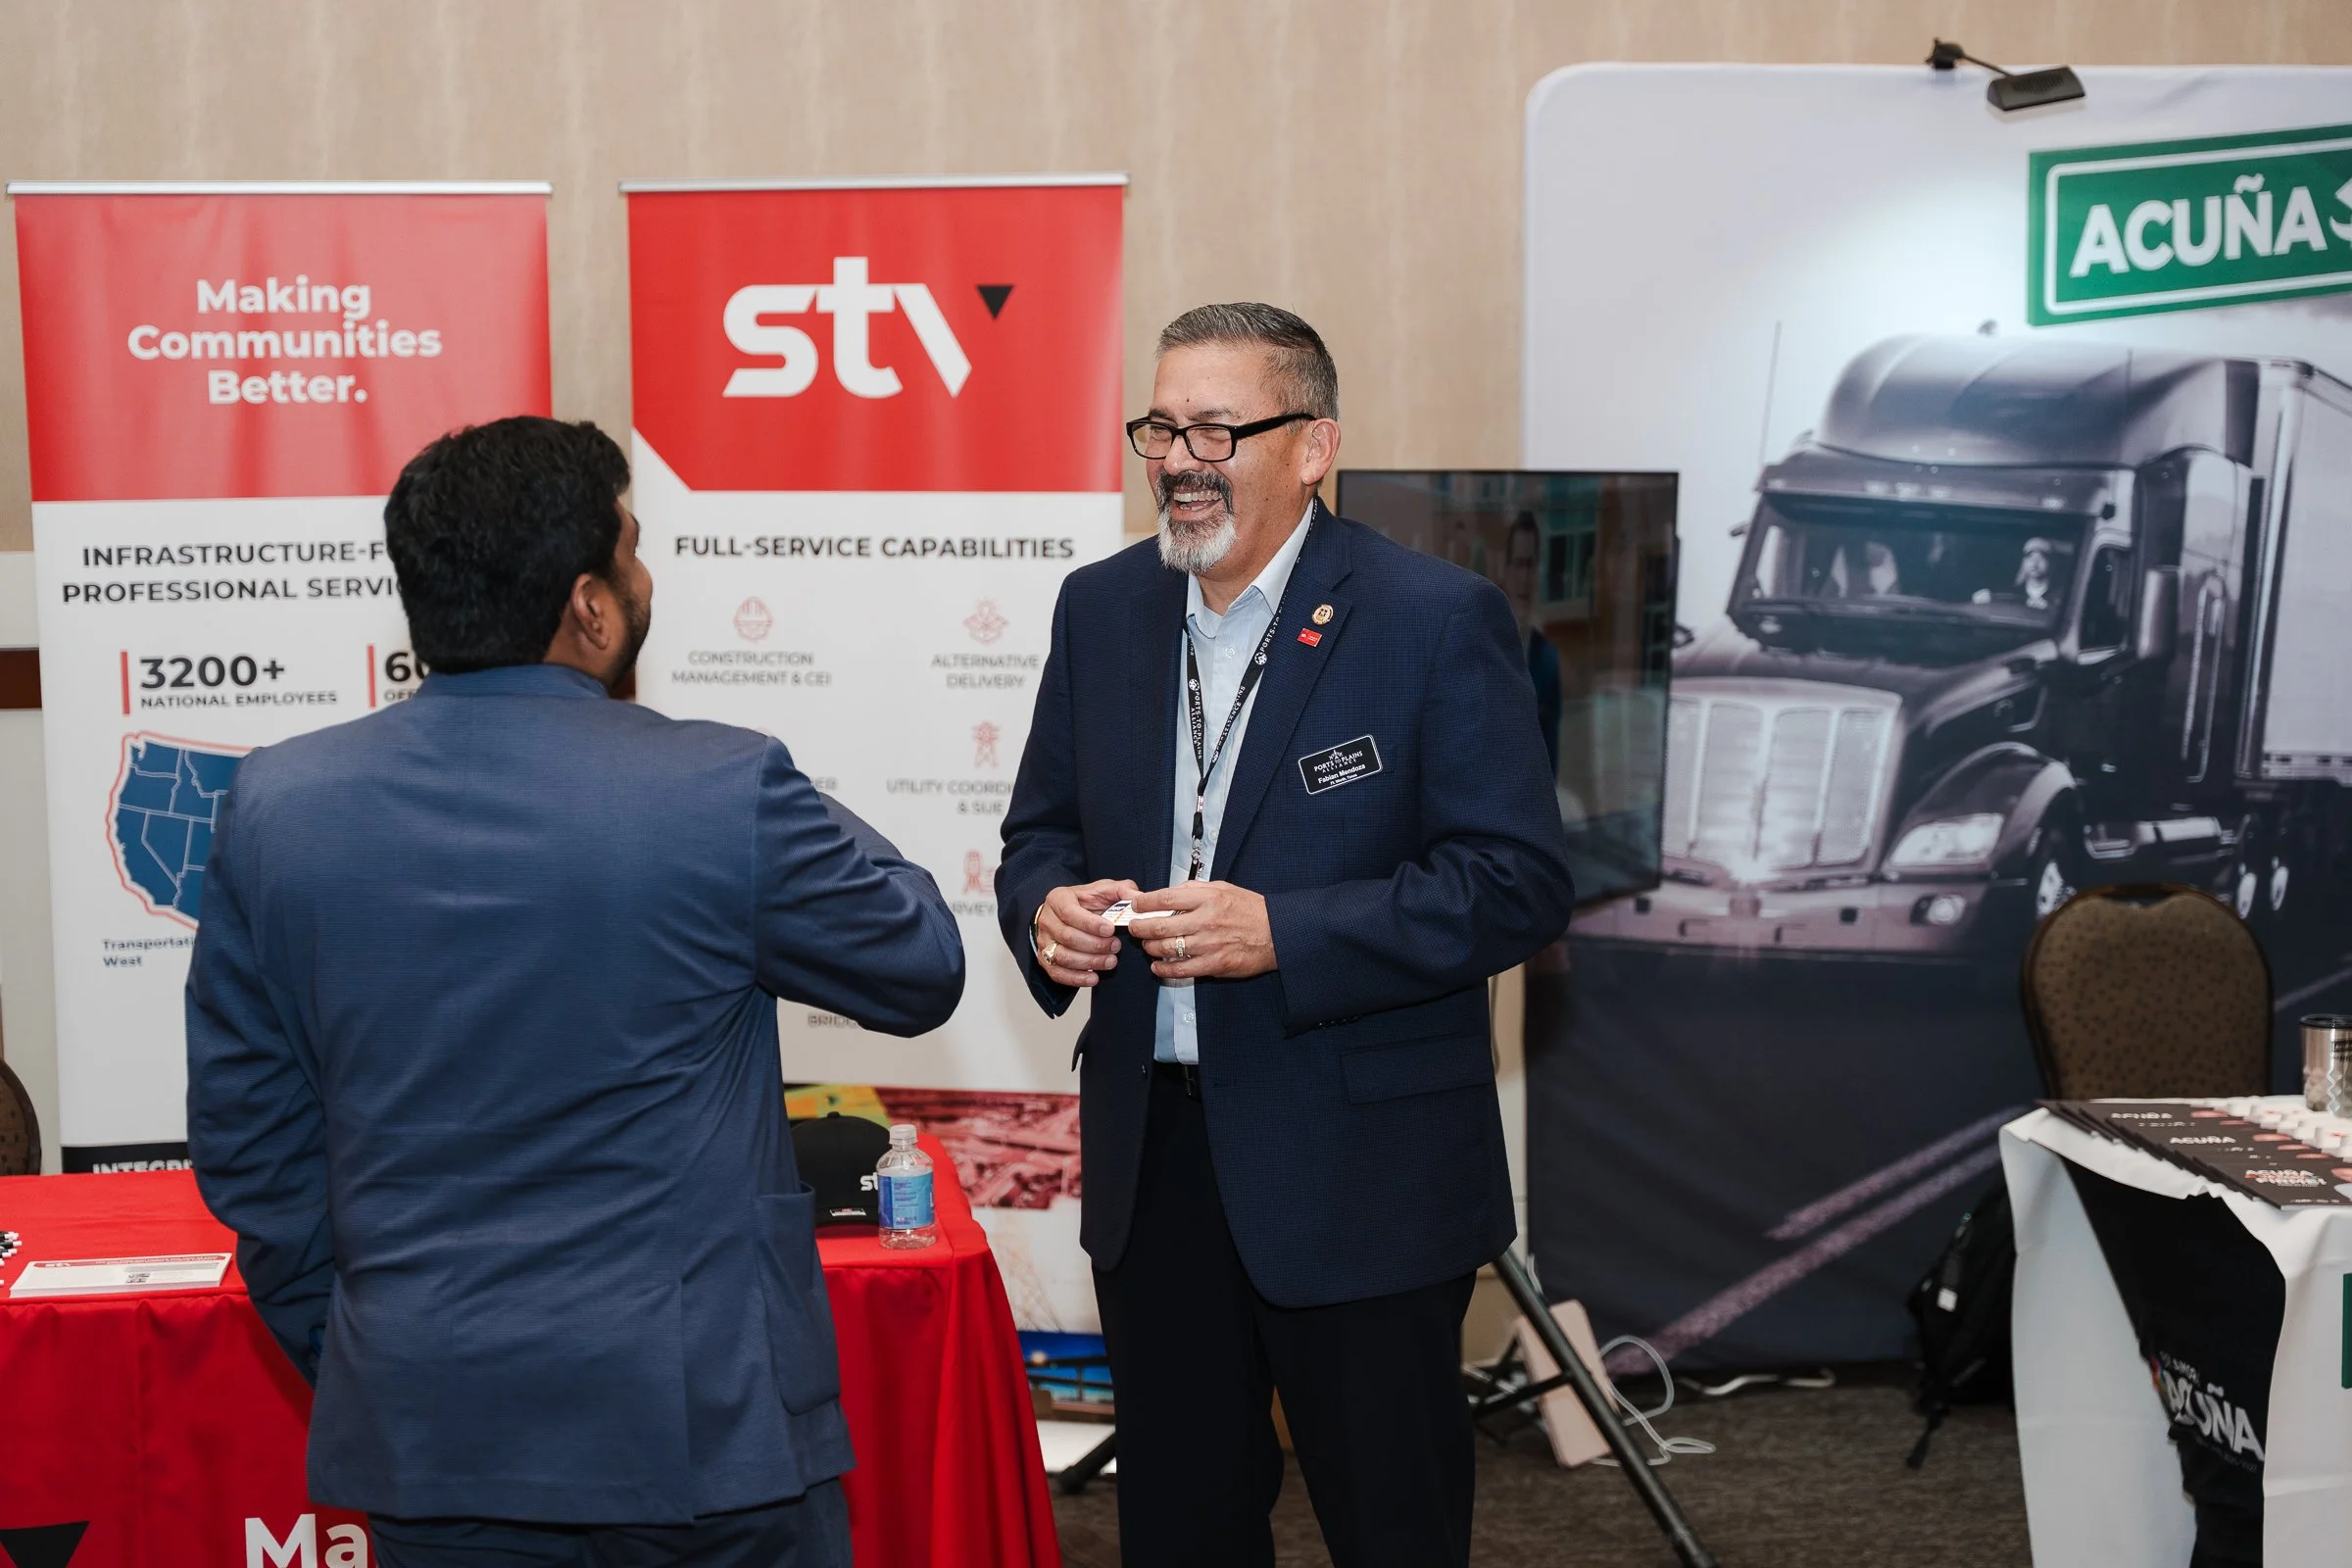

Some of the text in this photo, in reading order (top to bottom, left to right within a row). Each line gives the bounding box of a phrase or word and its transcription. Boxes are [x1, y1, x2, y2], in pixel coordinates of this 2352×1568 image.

[2069, 172, 2328, 277] ACUÑA
[196, 275, 371, 320] Making
[722, 256, 1016, 399] stv
[127, 318, 443, 361] Communities
[207, 368, 368, 405] Better.
[674, 536, 1075, 559] FULL-SERVICE CAPABILITIES
[62, 579, 298, 605] PROFESSIONAL
[688, 651, 813, 666] CONSTRUCTION
[931, 654, 1040, 669] ALTERNATIVE
[139, 655, 285, 689] 3200+
[670, 670, 832, 686] MANAGEMENT & CEI
[946, 673, 1025, 689] DELIVERY
[140, 694, 230, 709] NATIONAL
[235, 691, 338, 706] EMPLOYEES
[1313, 760, 1335, 772] PORTS
[1342, 751, 1363, 762] PLAINS
[1317, 764, 1366, 784] Fabian Mendoza
[886, 779, 943, 794] UTILITY
[102, 956, 143, 967] West
[244, 1513, 368, 1568] Ma
